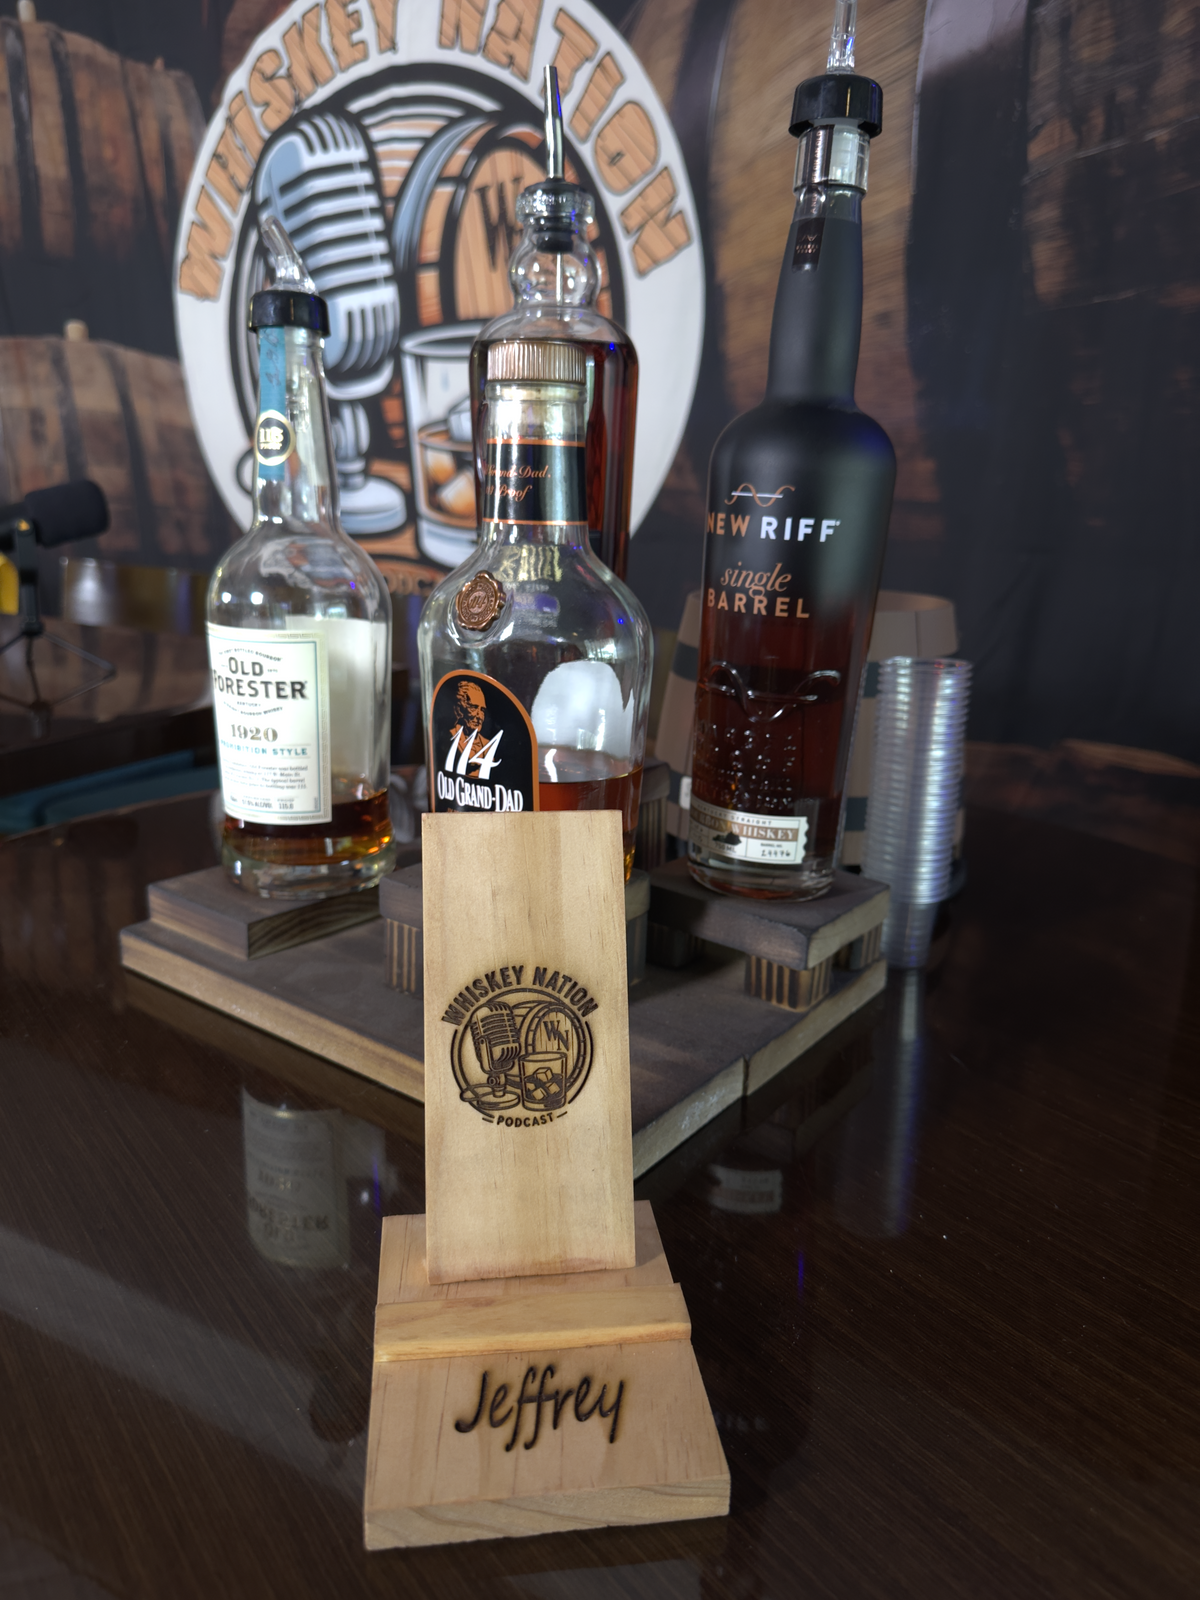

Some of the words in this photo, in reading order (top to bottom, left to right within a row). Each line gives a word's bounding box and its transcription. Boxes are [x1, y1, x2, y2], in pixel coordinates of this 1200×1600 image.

[178, 0, 397, 301] WHISKEY
[439, 0, 693, 276] NATION
[707, 511, 752, 538] NEW
[760, 515, 835, 542] RIFF
[720, 561, 793, 599] single
[707, 588, 810, 619] BARREL
[228, 656, 264, 677] OLD
[212, 669, 306, 701] FORESTER
[230, 723, 279, 743] 1920
[272, 747, 308, 756] STYLE
[444, 725, 504, 780] 114
[437, 770, 455, 801] OLD
[455, 776, 524, 812] GRAND-DAD
[730, 814, 773, 826] STRAIGHT
[731, 822, 794, 840] WHISKEY
[441, 965, 525, 1027] WHISKEY
[532, 966, 599, 1019] NATION
[496, 1112, 555, 1128] PODCAST
[454, 1363, 626, 1453] Jeffrey
